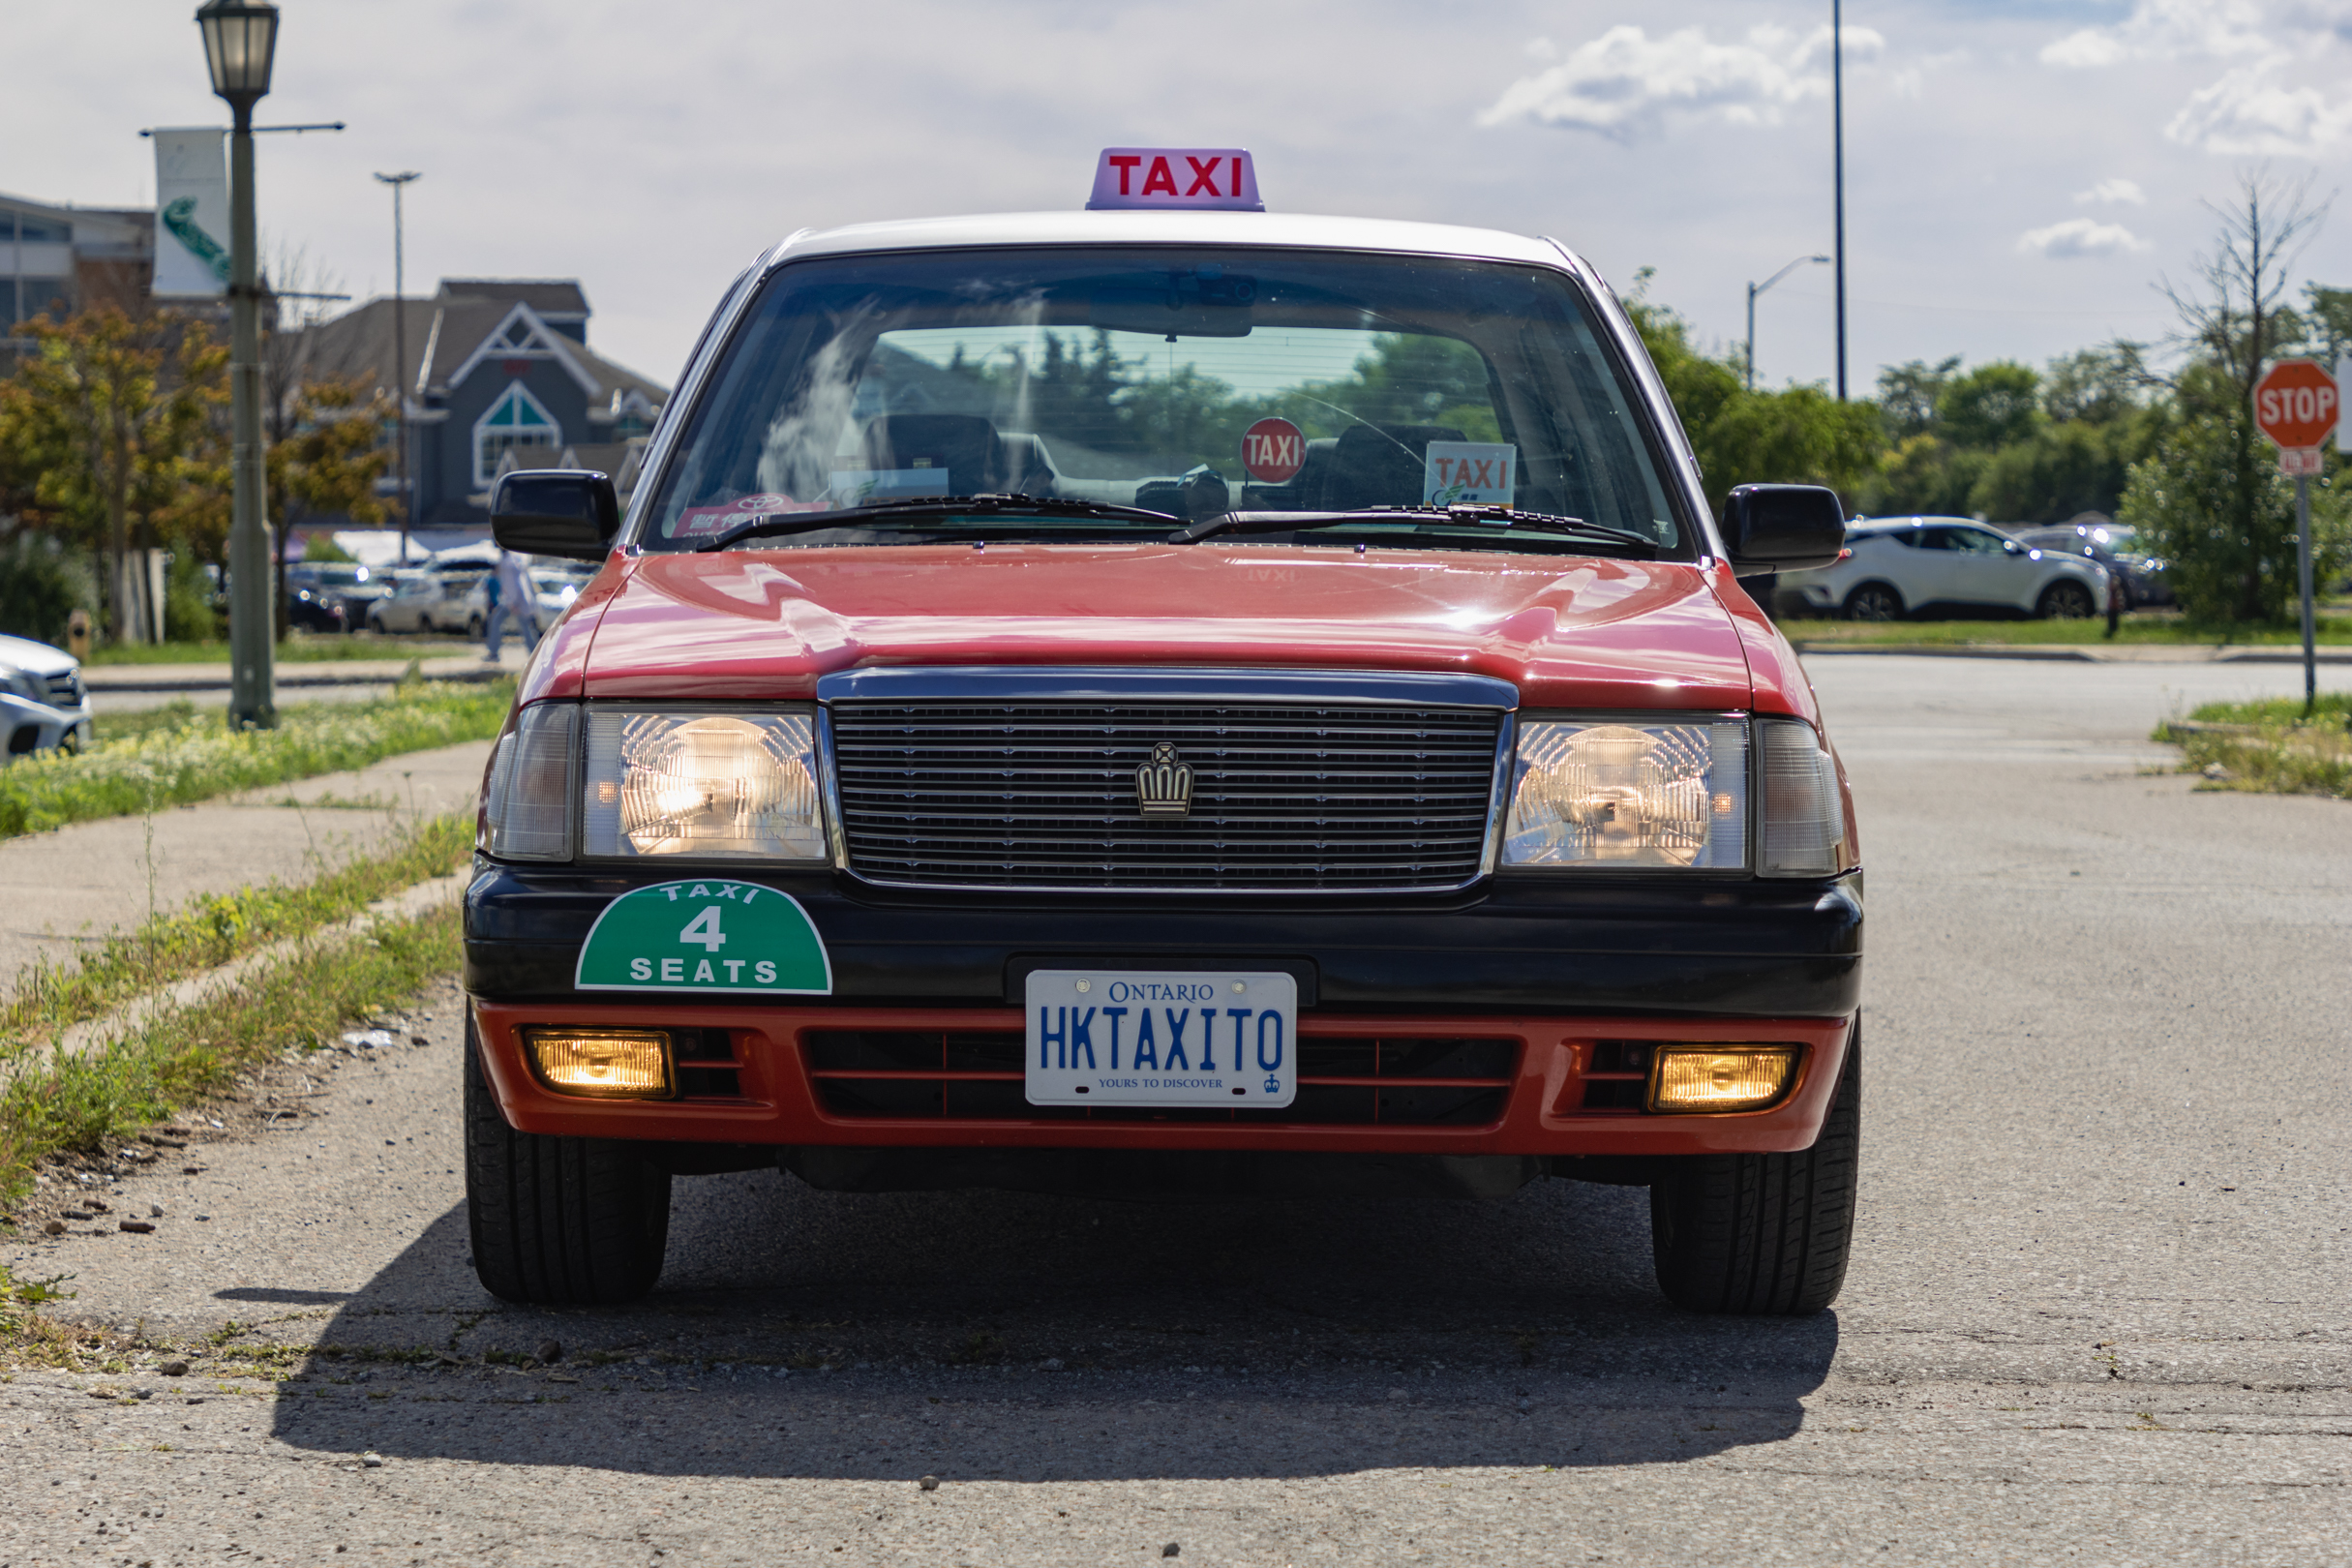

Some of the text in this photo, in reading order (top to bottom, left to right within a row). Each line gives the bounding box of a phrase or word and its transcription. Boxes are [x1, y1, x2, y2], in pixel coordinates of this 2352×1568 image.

[1109, 156, 1242, 196] TAXI
[2261, 386, 2336, 425] STOP
[1246, 435, 1300, 467] TAXI
[1435, 458, 1507, 489] TAXI
[659, 884, 760, 904] TAXI
[679, 905, 726, 952] 4
[629, 957, 777, 983] SEATS
[1040, 1006, 1282, 1071] HKTAXITO
[1099, 1078, 1222, 1089] YOURS TO DISCOVER
